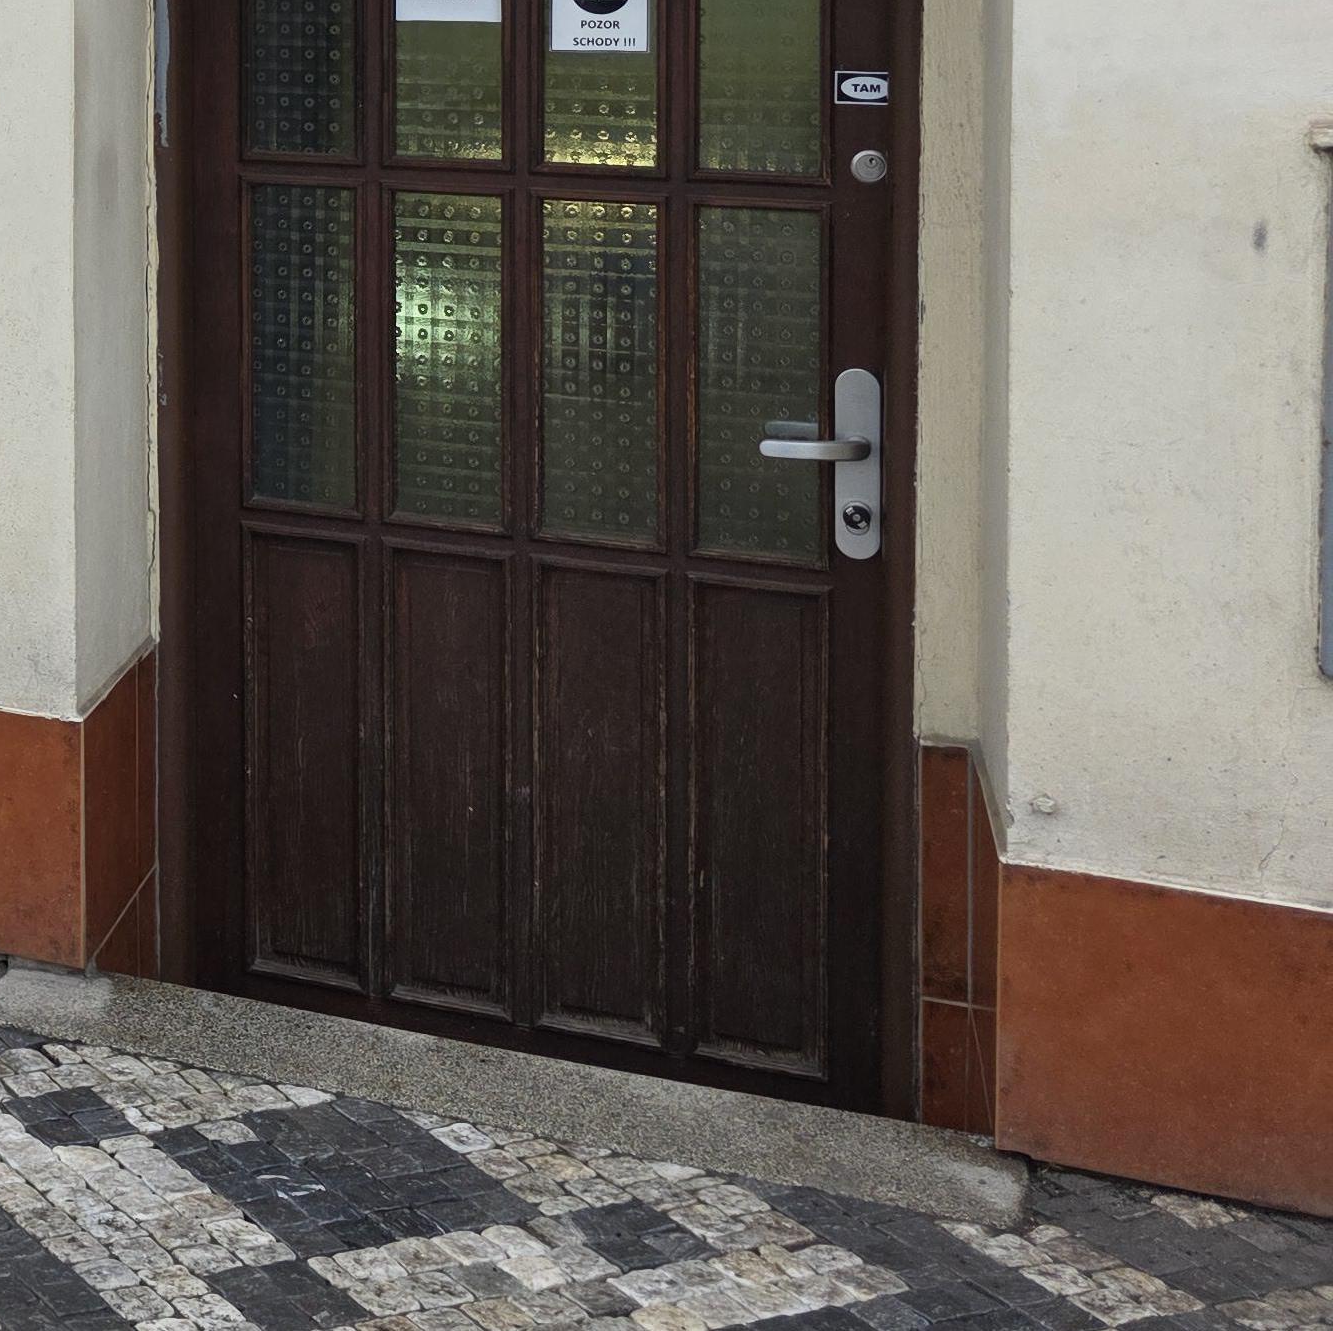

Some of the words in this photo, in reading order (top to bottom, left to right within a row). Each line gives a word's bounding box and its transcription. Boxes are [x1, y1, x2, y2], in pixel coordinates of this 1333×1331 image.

[580, 19, 620, 29] POZOR
[573, 37, 620, 46] SCHODY
[851, 83, 881, 93] TAM
